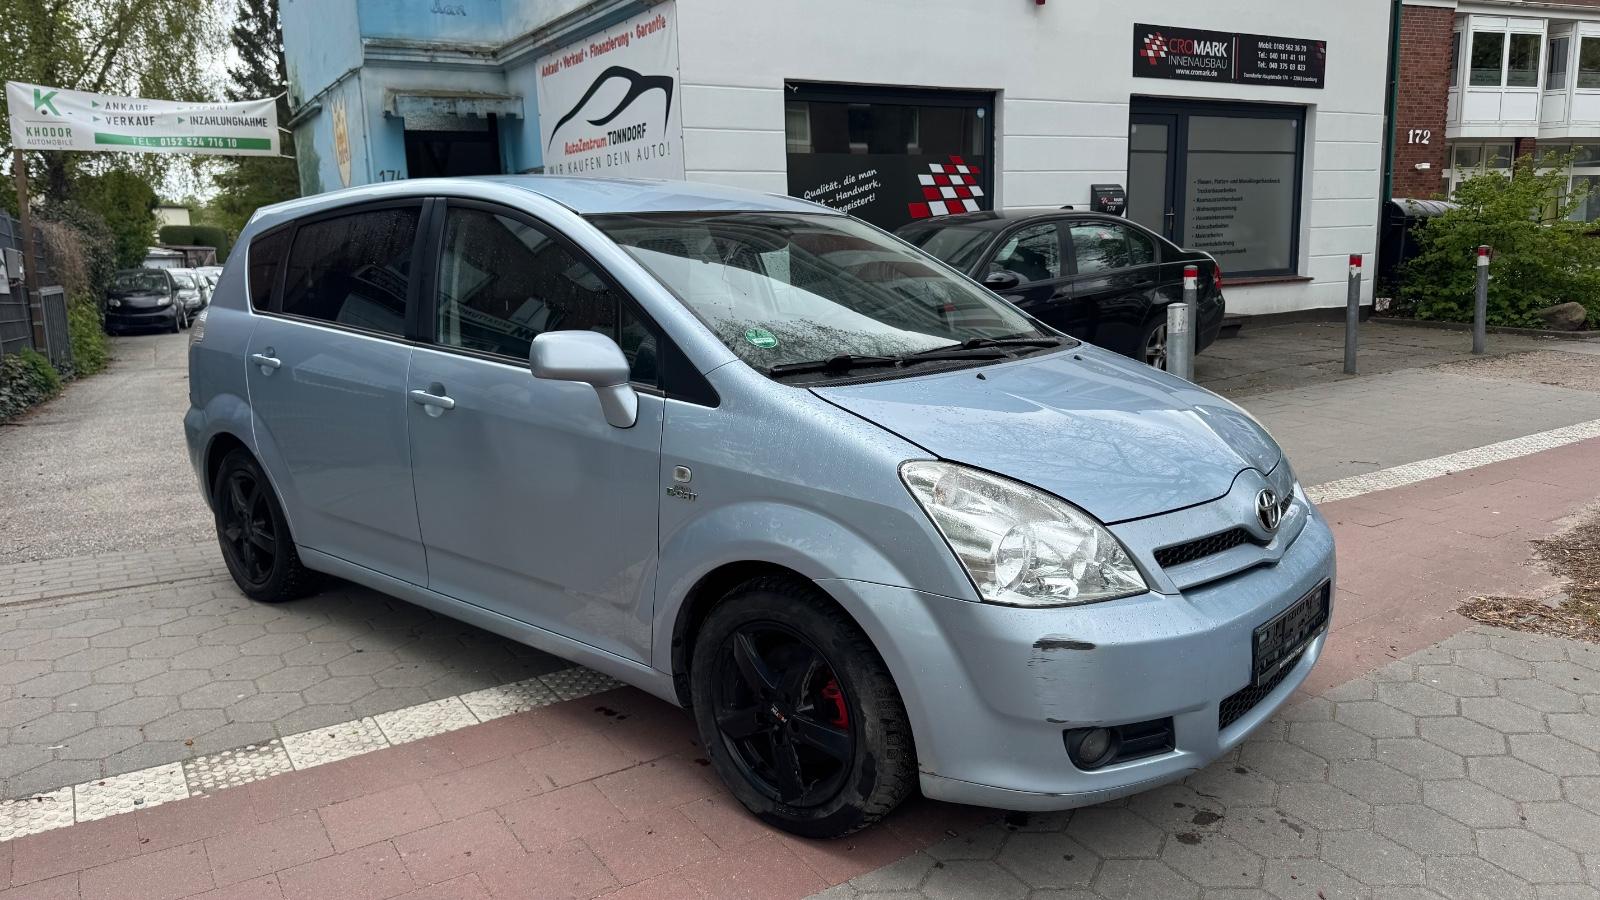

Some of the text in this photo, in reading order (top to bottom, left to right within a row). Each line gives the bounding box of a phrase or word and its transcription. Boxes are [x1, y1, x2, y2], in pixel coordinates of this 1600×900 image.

[542, 14, 666, 77] Ankauf Verkauf Finanzierung Garantie
[1169, 38, 1228, 57] CROMARK
[1168, 55, 1228, 69] INNENAUSBAU
[1175, 68, 1218, 77] www.cromark.de
[34, 88, 61, 116] K
[105, 101, 149, 111] ANKAUF
[105, 116, 156, 127] VERKAUF
[189, 116, 268, 128] INZAHLUNGNAHME
[26, 126, 73, 138] KHODOR
[564, 122, 647, 156] AutoZentrum TONNDORF
[1407, 129, 1431, 145] 172
[160, 137, 183, 146] 0152
[186, 137, 204, 146] 524
[208, 138, 223, 147] 716
[227, 138, 237, 147] 10
[567, 156, 602, 174] KAUFEN
[606, 150, 630, 167] DEIN
[637, 141, 671, 161] AUTO!
[804, 169, 877, 200] Qualität, die man
[835, 180, 882, 205] Handwerk,
